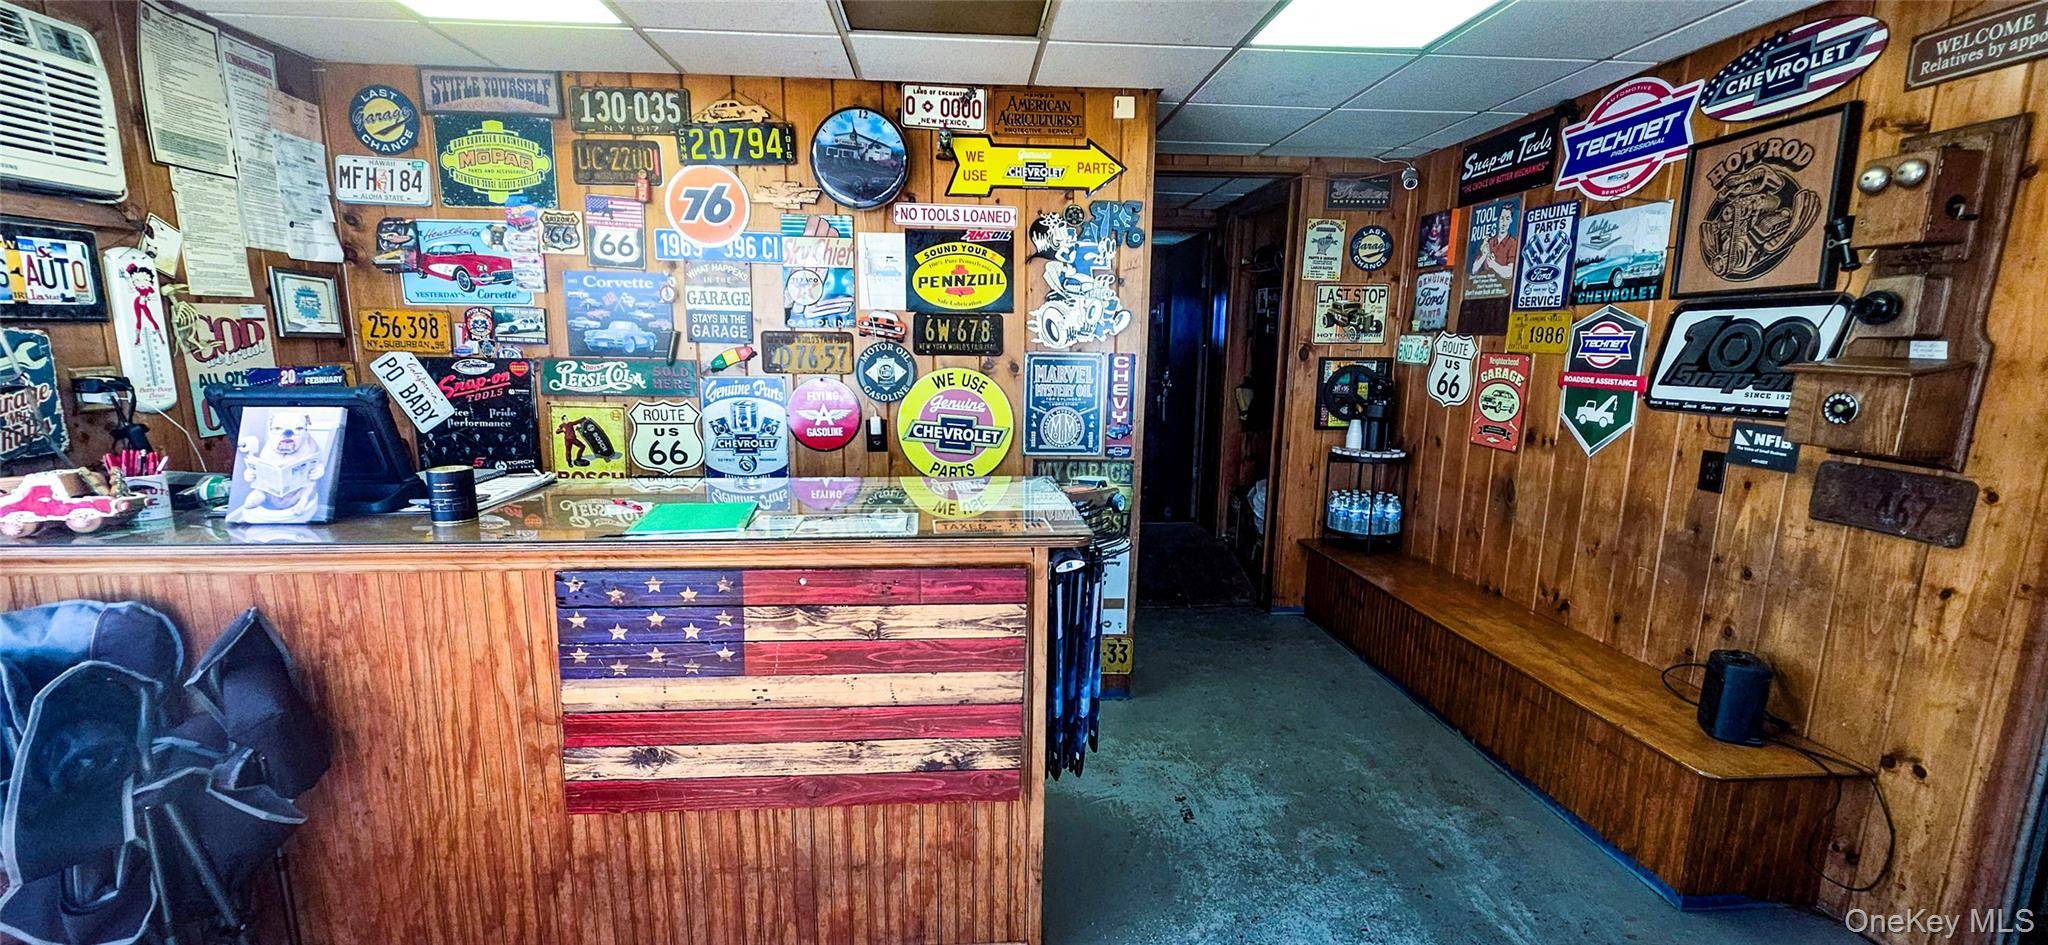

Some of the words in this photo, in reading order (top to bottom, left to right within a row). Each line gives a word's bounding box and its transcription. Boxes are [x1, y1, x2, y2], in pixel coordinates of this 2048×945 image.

[1936, 13, 2036, 55] WELCOME
[1920, 48, 1984, 75] Relatives
[1988, 42, 2006, 57] by
[1725, 41, 1851, 95] CHEVROLET
[360, 88, 398, 102] LAST
[430, 75, 478, 106] STIFLE
[482, 76, 550, 107] YOURSELF
[1606, 85, 1652, 106] AUTOMOTIVE
[579, 91, 681, 124] 130-035
[905, 95, 915, 116] 0
[940, 97, 982, 119] 0000
[1006, 95, 1071, 112] AMERICAN
[352, 104, 413, 131] Garage
[857, 110, 868, 119] 12
[996, 110, 1082, 127] AGRICULTURIST
[361, 129, 414, 152] CHANCE
[688, 127, 783, 160] 20794
[784, 127, 793, 160] 1915
[1576, 110, 1684, 160] TECHNET
[678, 128, 688, 160] CONN
[1610, 137, 1665, 158] PROFESSIONAL
[458, 148, 534, 172] MOPAR
[965, 150, 985, 163] WE
[1462, 148, 1513, 181] Snap-on
[1518, 127, 1553, 163] Tools
[1707, 141, 1764, 188] HOT
[1771, 137, 1815, 172] ROD
[963, 170, 987, 182] USE
[1008, 166, 1064, 178] CHEVROLET
[1077, 162, 1116, 175] PARTS
[339, 165, 377, 191] MFH
[387, 169, 422, 193] 184
[1602, 184, 1632, 195] SERVICE
[680, 183, 734, 228] 76
[1527, 202, 1577, 223] GENUINE
[544, 215, 576, 223] ARIZONA
[900, 207, 917, 220] NO
[922, 208, 960, 222] TOOLS
[963, 210, 1011, 224] LOANED
[1475, 205, 1498, 225] TOOL
[423, 225, 475, 243] Heartbeat
[551, 225, 574, 244] 66
[1363, 228, 1387, 238] LAST
[1470, 222, 1497, 242] RULES
[1534, 218, 1567, 234] PARTS
[965, 230, 1012, 241] AMSOIL
[1543, 232, 1551, 243] &
[600, 233, 638, 257] 66
[724, 236, 756, 260] 396
[762, 238, 779, 260] CI
[924, 244, 958, 260] SOUND
[961, 244, 988, 257] YOUR
[1353, 254, 1388, 271] CHANCE
[686, 263, 710, 280] WHAT
[711, 262, 749, 282] HAPPENS
[918, 272, 1005, 289] PENNZOIL
[1530, 268, 1554, 281] Ford
[582, 275, 654, 289] Corvette
[1418, 274, 1450, 289] GENUINE
[477, 288, 517, 299] Corvette
[686, 290, 751, 307] GARAGE
[1318, 288, 1351, 303] LAST
[1354, 288, 1387, 303] STOP
[1417, 287, 1447, 307] Ford
[1519, 294, 1561, 308] SERVICE
[1577, 285, 1658, 304] CHEVROLET
[692, 313, 718, 324] STAYS
[719, 314, 729, 324] IN
[730, 314, 746, 324] THE
[787, 318, 854, 327] GASOLINE
[691, 324, 748, 339] GARAGE
[1529, 326, 1565, 344] 1986
[367, 340, 378, 348] NY
[384, 341, 430, 349] SUBURBAN
[1441, 341, 1469, 357] ROUTE
[1583, 339, 1628, 348] TECHNET
[1683, 313, 1821, 377] 100
[861, 343, 894, 362] MOTOR
[897, 347, 910, 363] OIL
[1488, 356, 1520, 367] Neighborhood
[652, 366, 690, 378] SOLD
[1445, 359, 1461, 371] US
[198, 373, 219, 388] ALL
[280, 370, 296, 385] 20
[304, 375, 343, 385] FEBRUARY
[549, 360, 648, 392] PEPSI-COLA
[1034, 365, 1094, 384] MARVEL
[1480, 367, 1526, 388] GARAGE
[1563, 375, 1596, 385] ROADSIDE
[1595, 377, 1638, 388] ASSISTANCE
[377, 356, 405, 382] PO
[400, 382, 439, 424] BABY
[406, 362, 438, 405] California
[437, 370, 511, 399] Snap-on
[653, 379, 692, 390] HERE
[705, 380, 751, 402] Genuine
[752, 380, 784, 402] Parts
[931, 374, 955, 390] WE
[962, 373, 989, 395] USE
[1035, 384, 1076, 397] MYSTERY
[1076, 384, 1094, 398] OIL
[1112, 356, 1130, 423] CHEVY
[1436, 371, 1461, 399] 66
[466, 388, 504, 402] TOOLS
[806, 391, 839, 401] FLYING
[863, 384, 910, 402] GASOLINE
[1743, 391, 1772, 400] SINCE
[929, 394, 986, 414] Genuine
[489, 407, 517, 419] Pride
[643, 409, 686, 422] ROUTE
[815, 403, 833, 426] A
[447, 418, 512, 429] Performance
[654, 427, 679, 437] US
[806, 427, 843, 437] GASOLINE
[913, 423, 1000, 444] CHEVROLET
[1753, 433, 1792, 450] NFIB
[718, 439, 775, 448] CHEVROLET
[649, 440, 689, 466] 66
[929, 462, 975, 478] PARTS
[1037, 461, 1063, 480] MY
[1066, 462, 1132, 483] GARAGE
